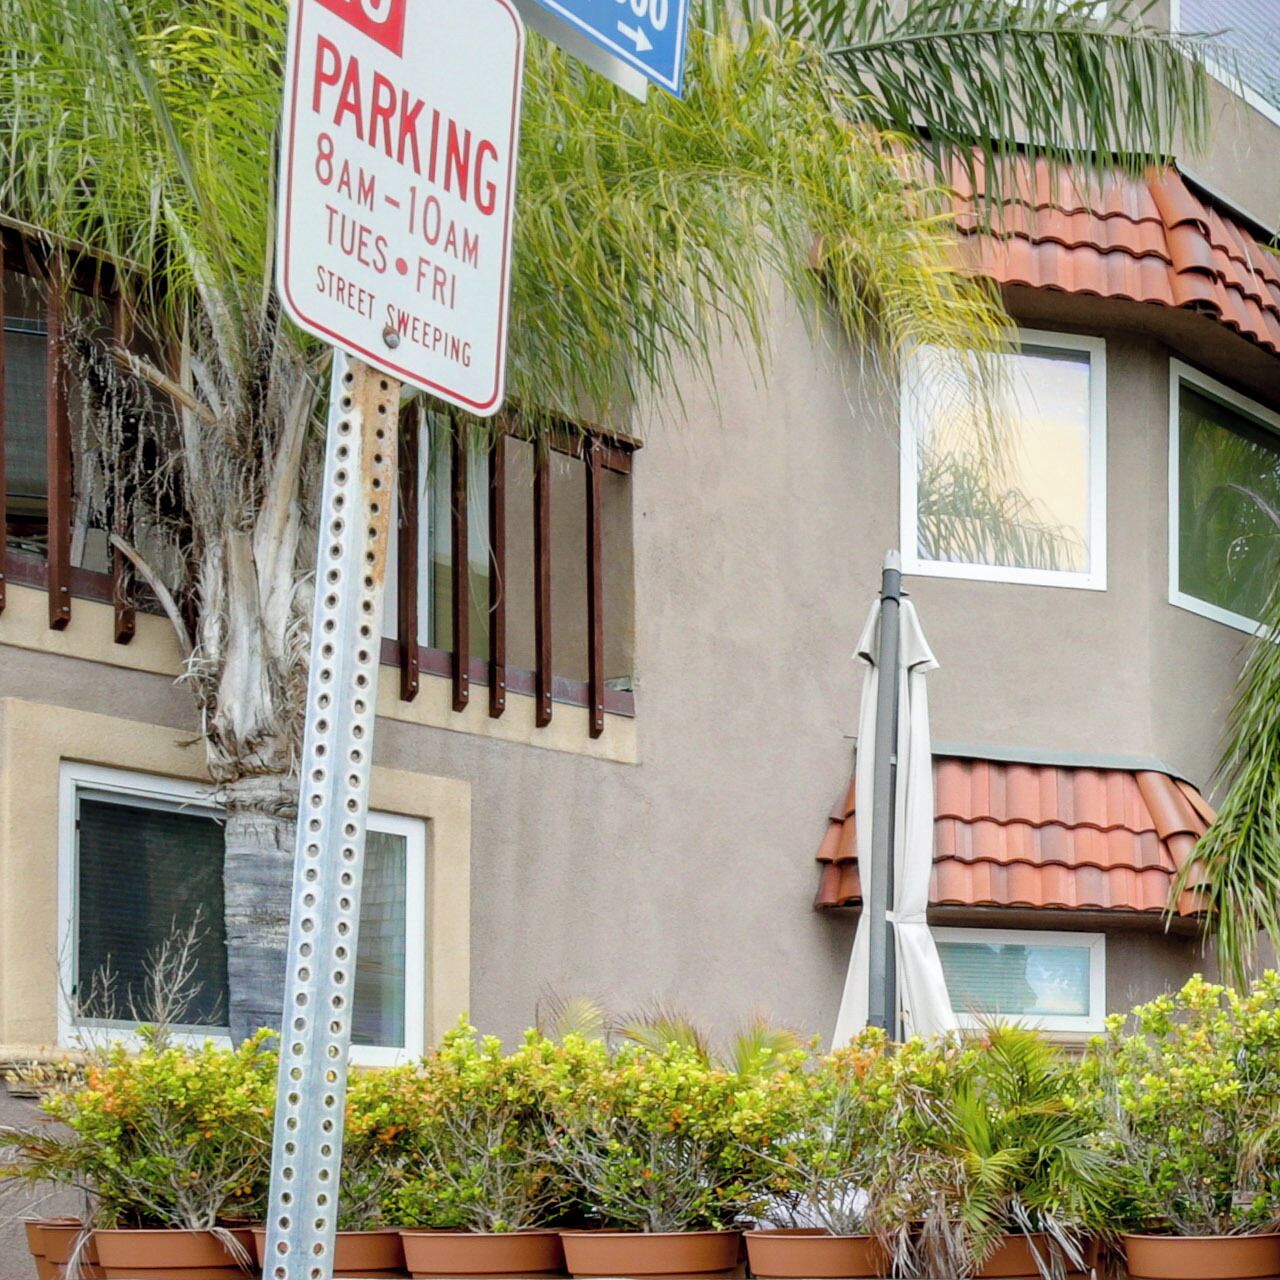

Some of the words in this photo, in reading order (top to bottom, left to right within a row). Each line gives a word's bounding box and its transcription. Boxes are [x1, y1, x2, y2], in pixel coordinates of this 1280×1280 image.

[311, 33, 499, 217] PARKING
[325, 203, 389, 274] TUES
[416, 256, 457, 311] FRI
[316, 265, 376, 320] STREET
[385, 303, 472, 368] SWEEPING
